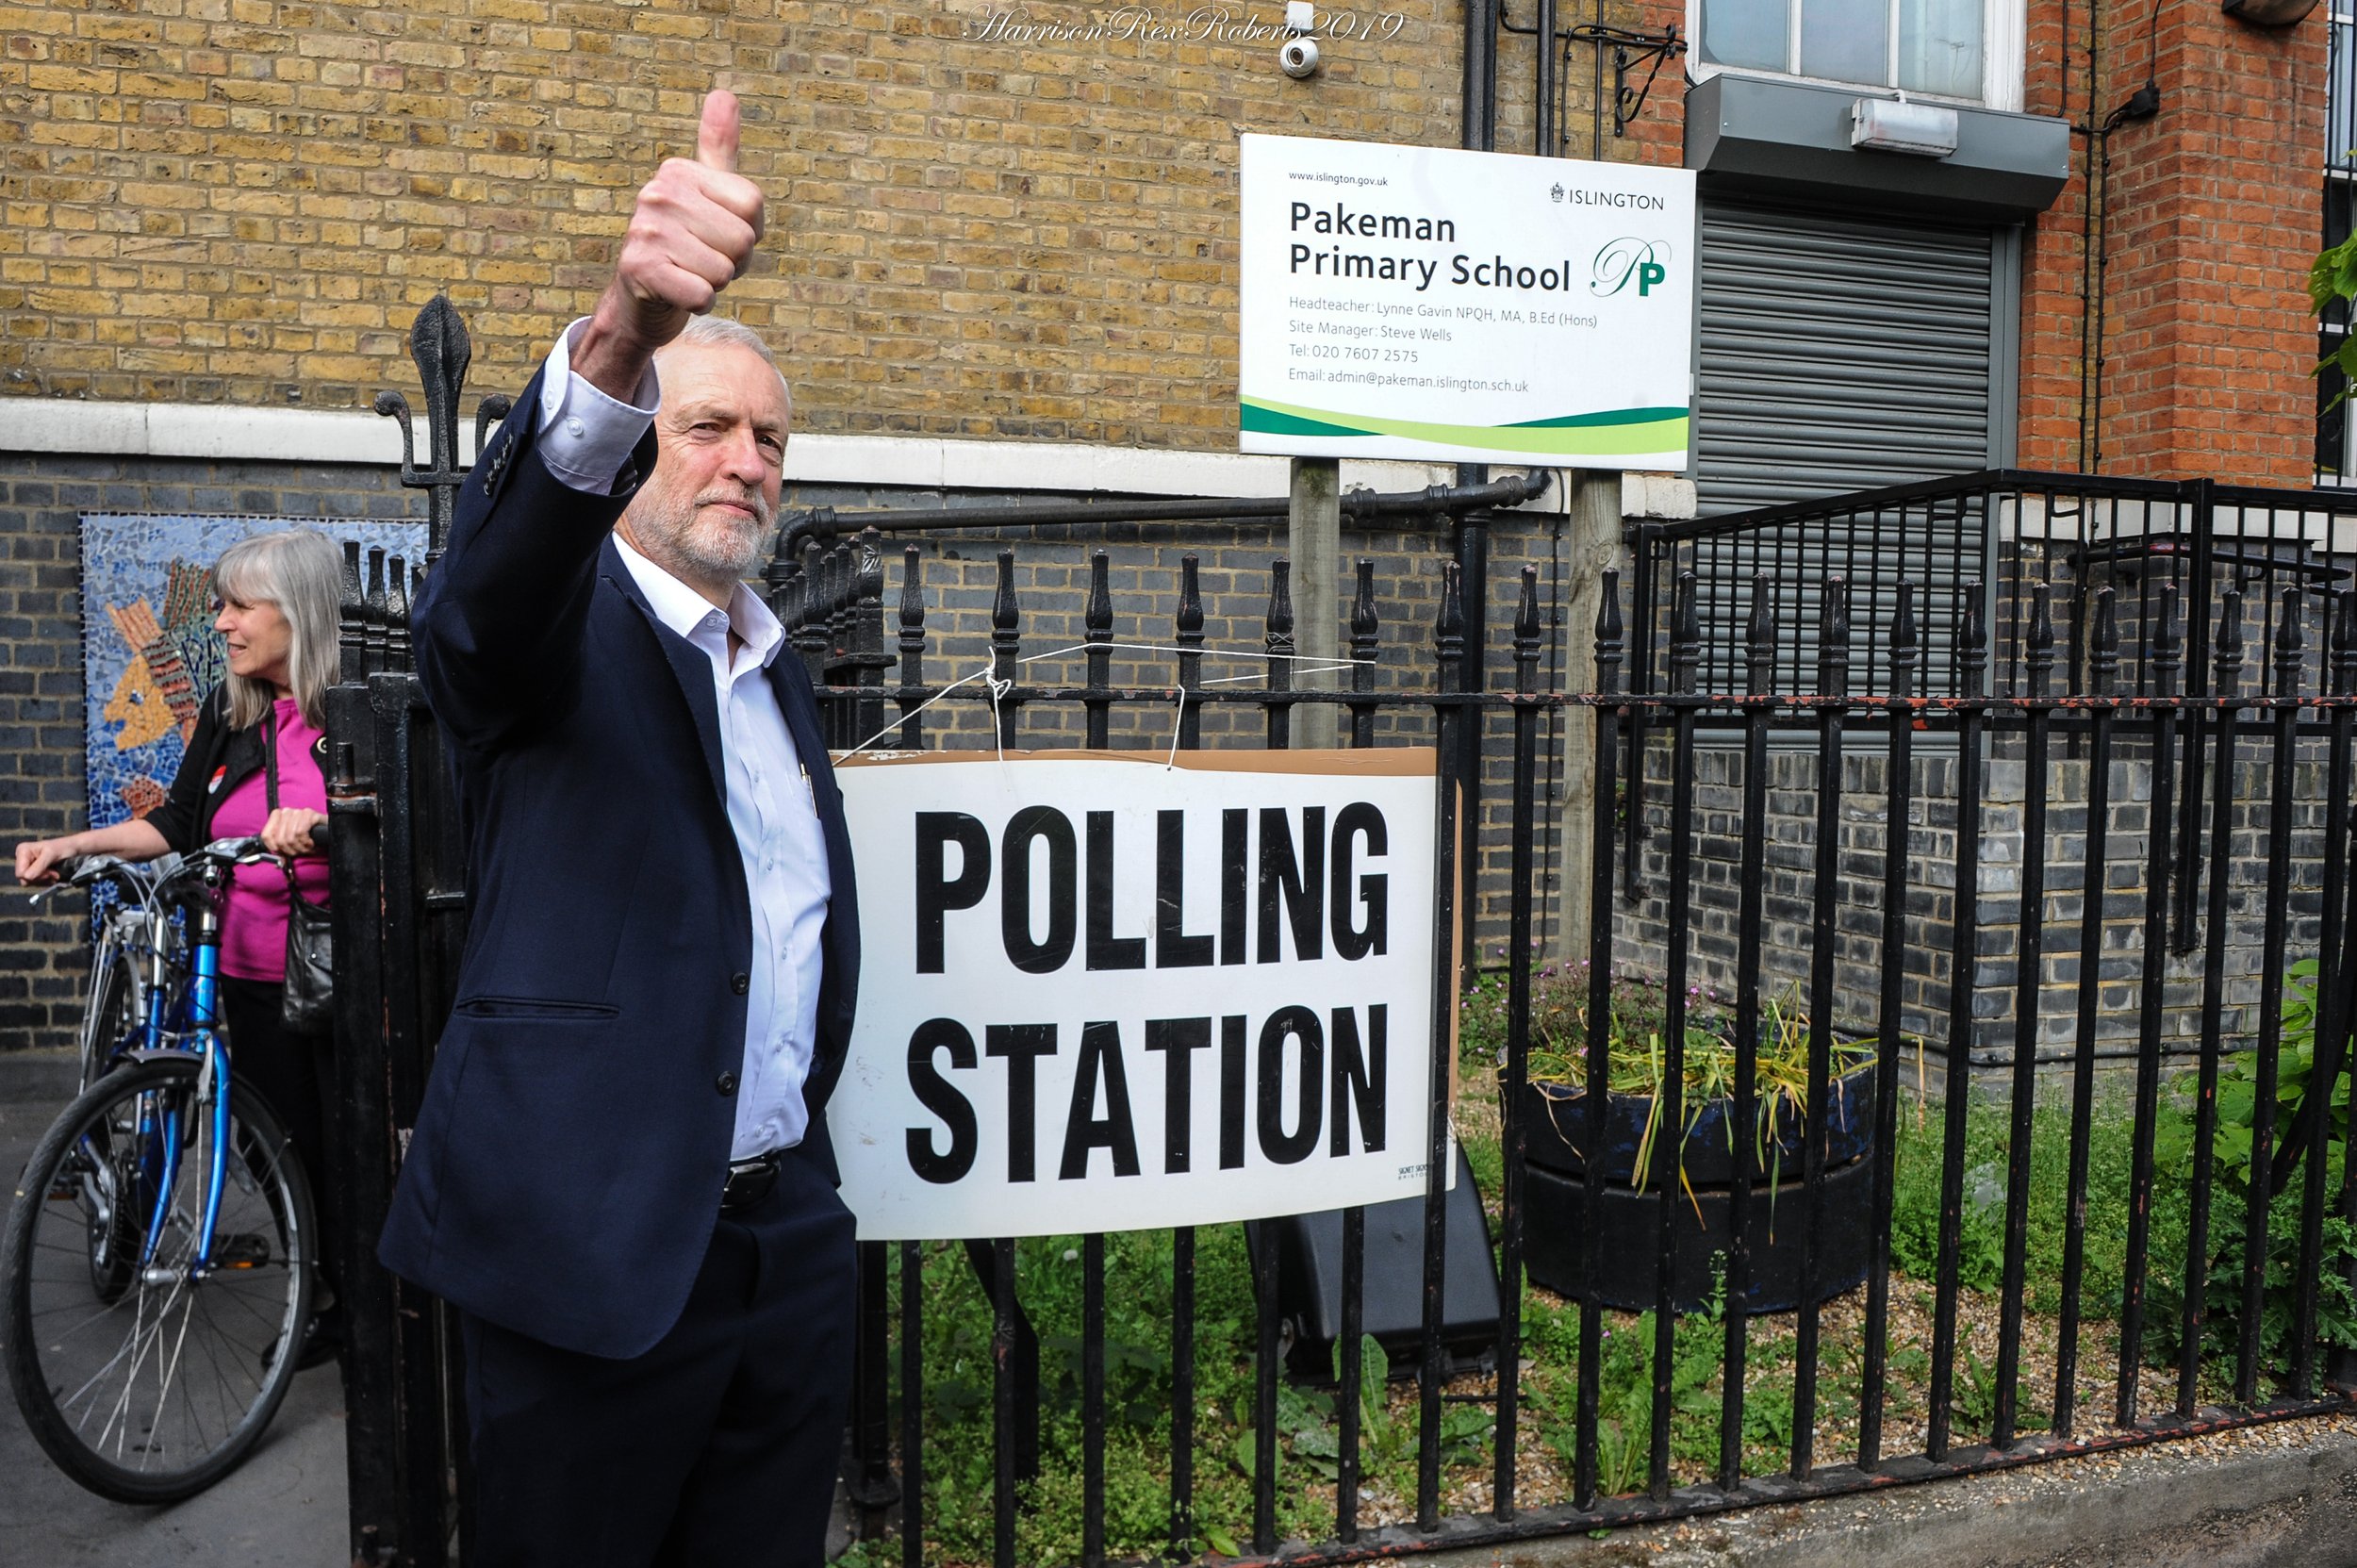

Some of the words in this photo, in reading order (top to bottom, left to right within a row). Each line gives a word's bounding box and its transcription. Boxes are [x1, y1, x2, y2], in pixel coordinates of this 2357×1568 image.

[1288, 172, 1389, 187] www.islington.gov.uk
[1569, 189, 1664, 211] ISLINGTON
[1291, 201, 1456, 242] Pakeman
[1291, 243, 1438, 291] Primary
[1452, 254, 1570, 291] School
[1289, 296, 1375, 313] Headteacher:
[1376, 302, 1414, 317] Lynne
[1417, 304, 1453, 319] Gavin
[1456, 306, 1496, 322] NPQH,
[1501, 309, 1525, 324] MA,
[1529, 311, 1556, 324] B.Ed
[1559, 312, 1598, 328] (Hons)
[1289, 320, 1314, 334] Site
[1318, 322, 1378, 339] Manager:
[1380, 324, 1416, 339] Steve
[1420, 328, 1453, 342] Wells
[1289, 343, 1310, 357] Tel:
[1311, 345, 1340, 358] 020
[1344, 347, 1379, 361] 7607
[1384, 349, 1419, 363] 2575
[1289, 368, 1327, 382] Email:
[1327, 371, 1529, 393] admin@pakeman.islington.sch.uk
[915, 801, 1389, 974] POLLING
[905, 1003, 1388, 1184] STATION
